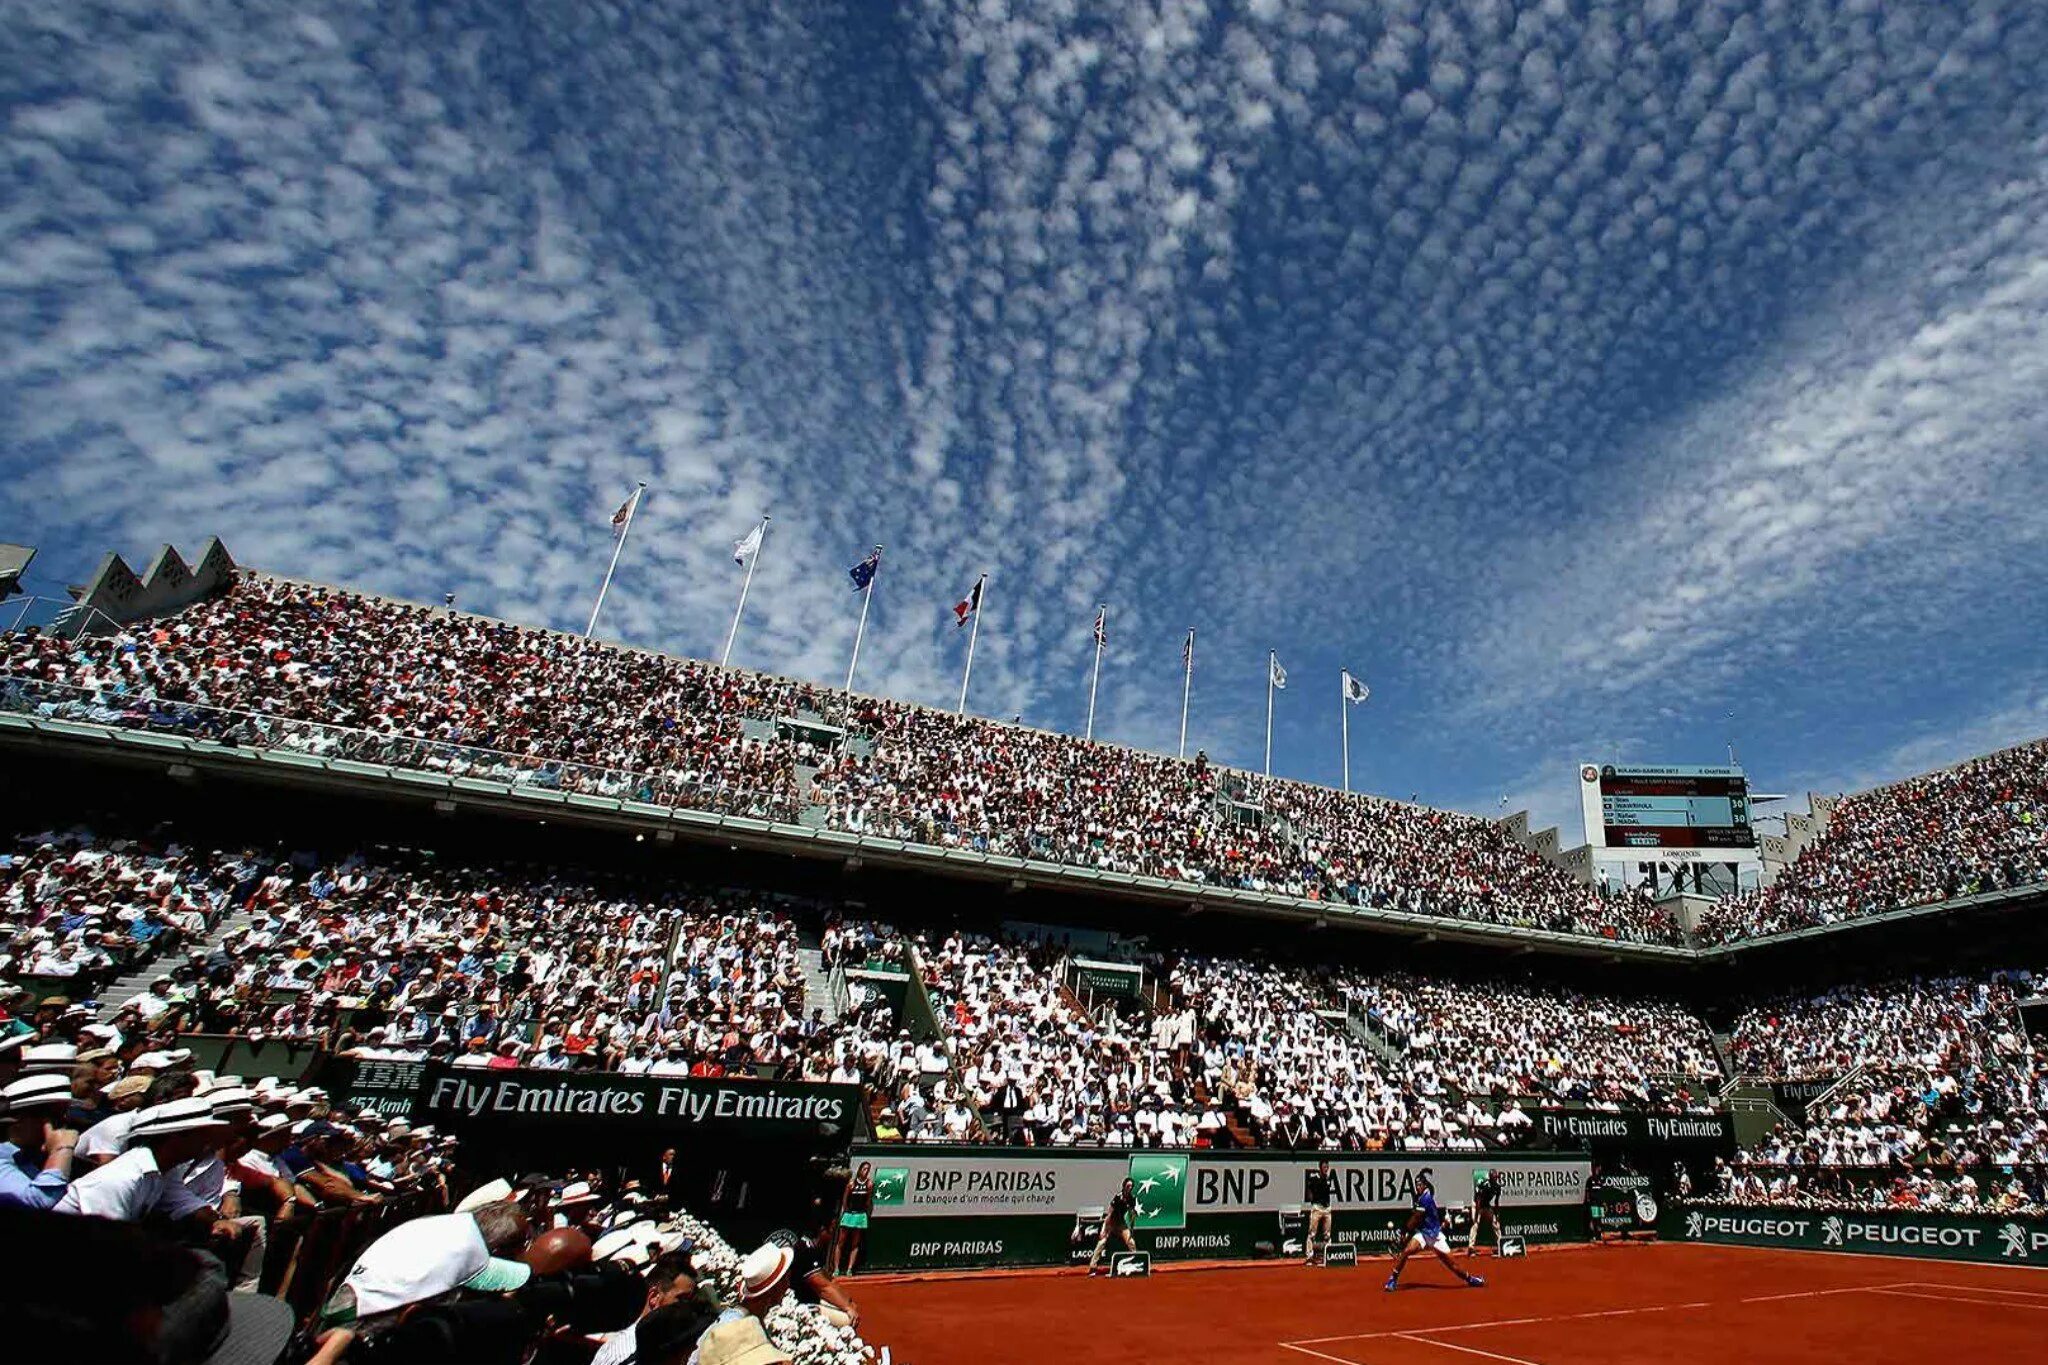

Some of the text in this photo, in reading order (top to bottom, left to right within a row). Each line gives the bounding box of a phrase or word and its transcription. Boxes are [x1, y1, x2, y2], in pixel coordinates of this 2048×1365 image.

[1732, 800, 1744, 809] 30
[1733, 814, 1746, 823] 30
[351, 1061, 426, 1089] IBM
[428, 1077, 645, 1117] Fly Emirates
[657, 1086, 842, 1122] Fly Emirates
[1568, 1117, 1628, 1136] Emirates
[1647, 1118, 1722, 1141] Fly Emirates
[915, 1171, 1056, 1191] BNP PARIBAS
[1196, 1168, 1270, 1205] BNP
[1499, 1170, 1580, 1187] BNP PARIBAS
[1338, 1230, 1360, 1242] BNP
[1504, 1223, 1559, 1235] BNP PARIBAS
[1704, 1217, 1810, 1237] PEUGEOT
[1846, 1223, 1981, 1247] PEUGEOT
[910, 1240, 1003, 1256] BNP PARIBAS
[1155, 1234, 1231, 1249] BNP PARIBAS
[1072, 1250, 1107, 1258] LACOE
[1327, 1252, 1354, 1260] LACOSTE
